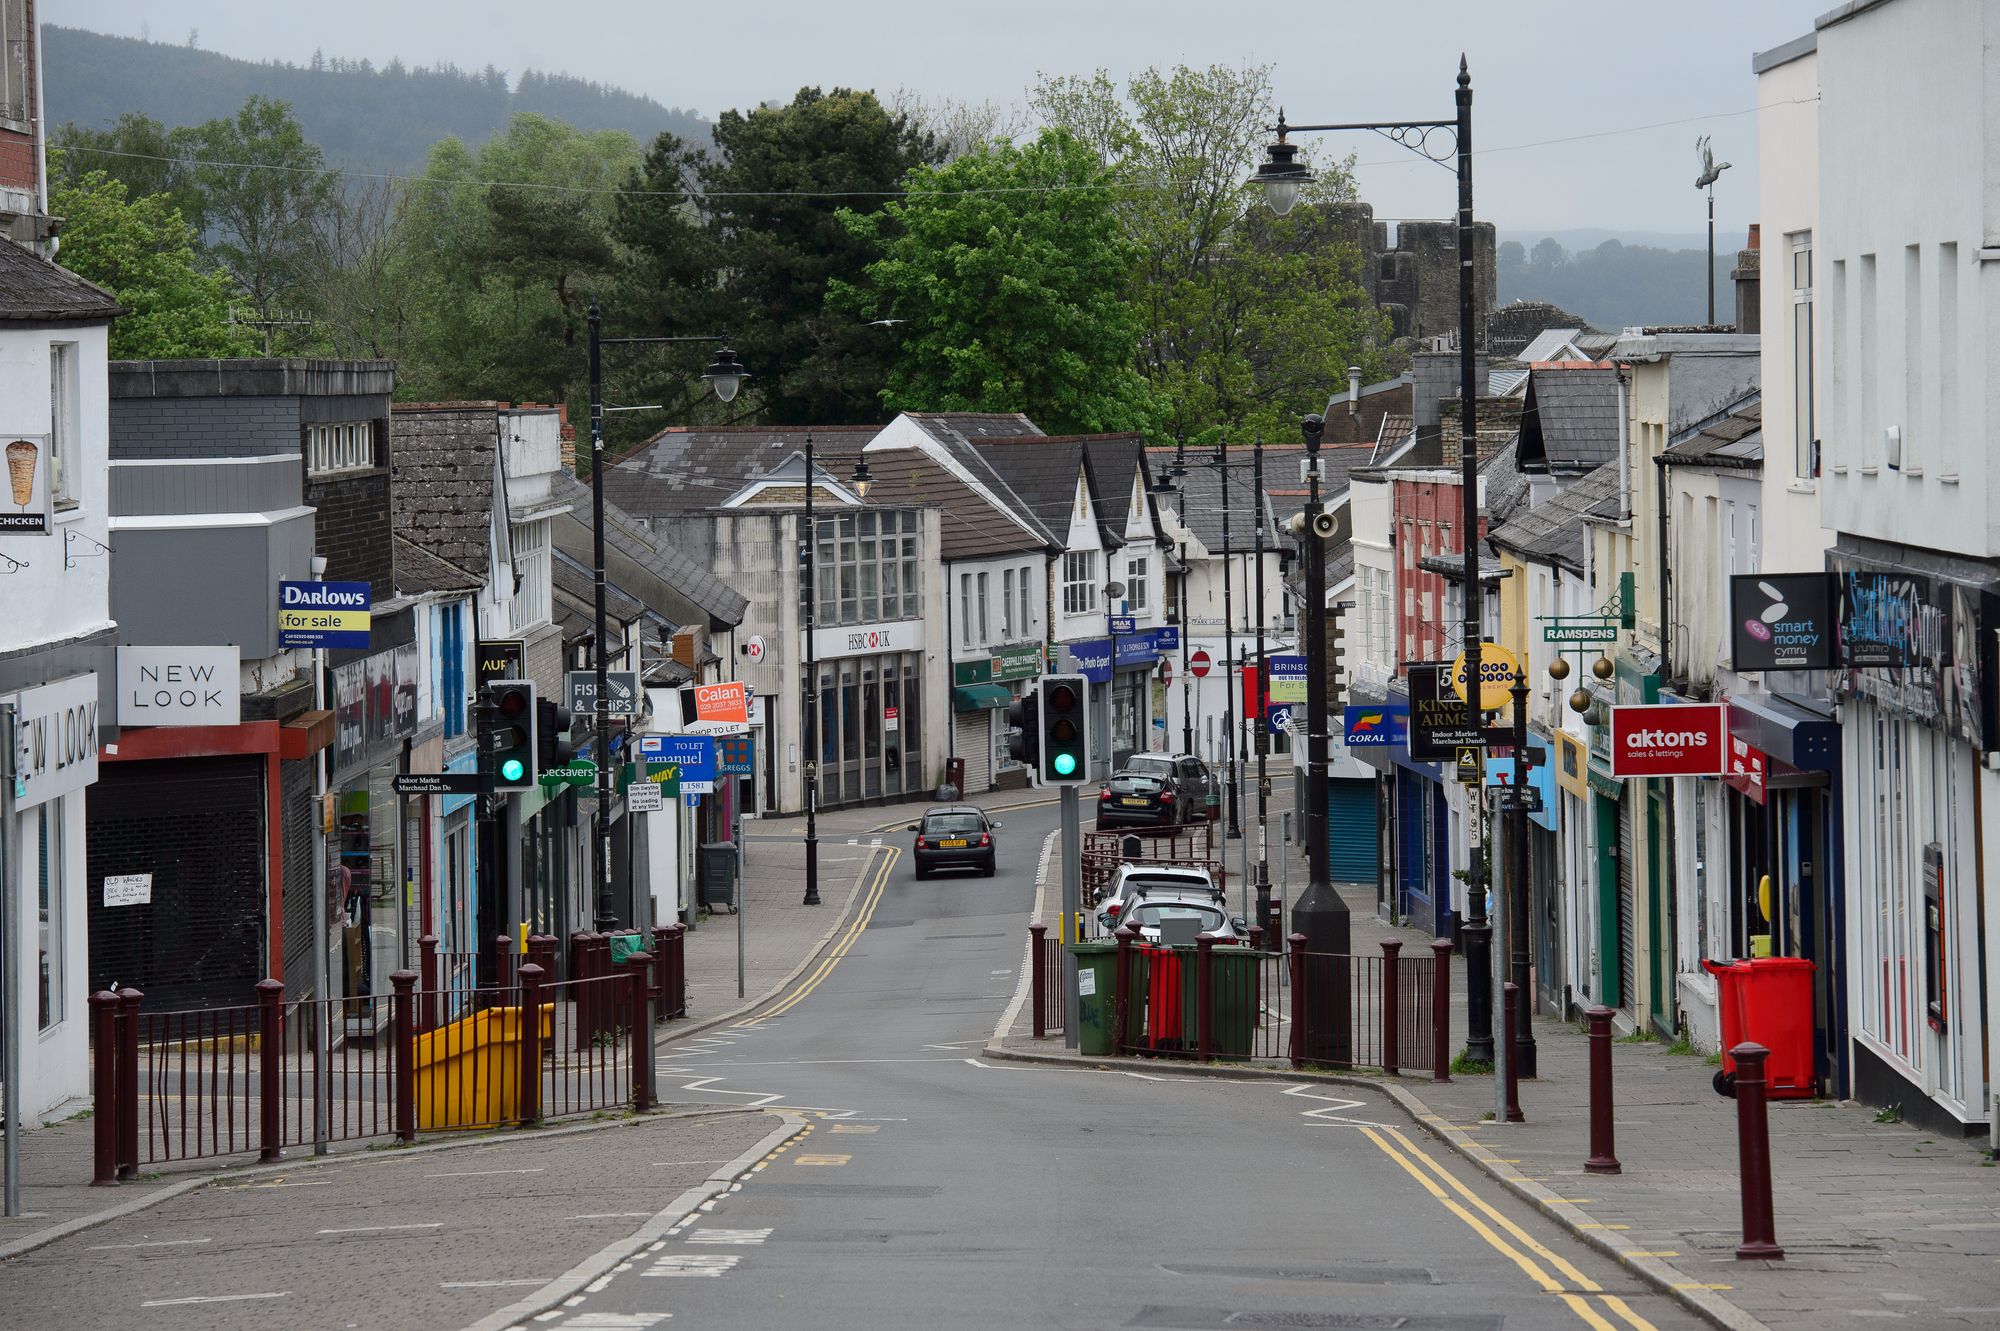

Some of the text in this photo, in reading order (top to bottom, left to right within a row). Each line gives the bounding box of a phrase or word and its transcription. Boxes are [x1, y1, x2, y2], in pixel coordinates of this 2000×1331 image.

[285, 614, 342, 627] for sale
[1774, 620, 1814, 633] smart
[848, 630, 890, 650] HSBC UK
[1547, 629, 1615, 639] RAMSDENS
[1774, 634, 1819, 646] money
[1774, 646, 1807, 657] cymru
[1084, 657, 1096, 669] Photo
[1096, 656, 1110, 672] Expert
[141, 665, 214, 682] NEW
[134, 690, 222, 707] LOOK
[575, 700, 585, 712] &
[1421, 713, 1469, 726] ARMS
[725, 724, 739, 732] LET
[56, 701, 98, 771] LOOK
[1348, 734, 1385, 742] CORAL
[1627, 729, 1708, 748] aktons
[647, 751, 702, 765] emanuel
[1655, 750, 1683, 758] lettings
